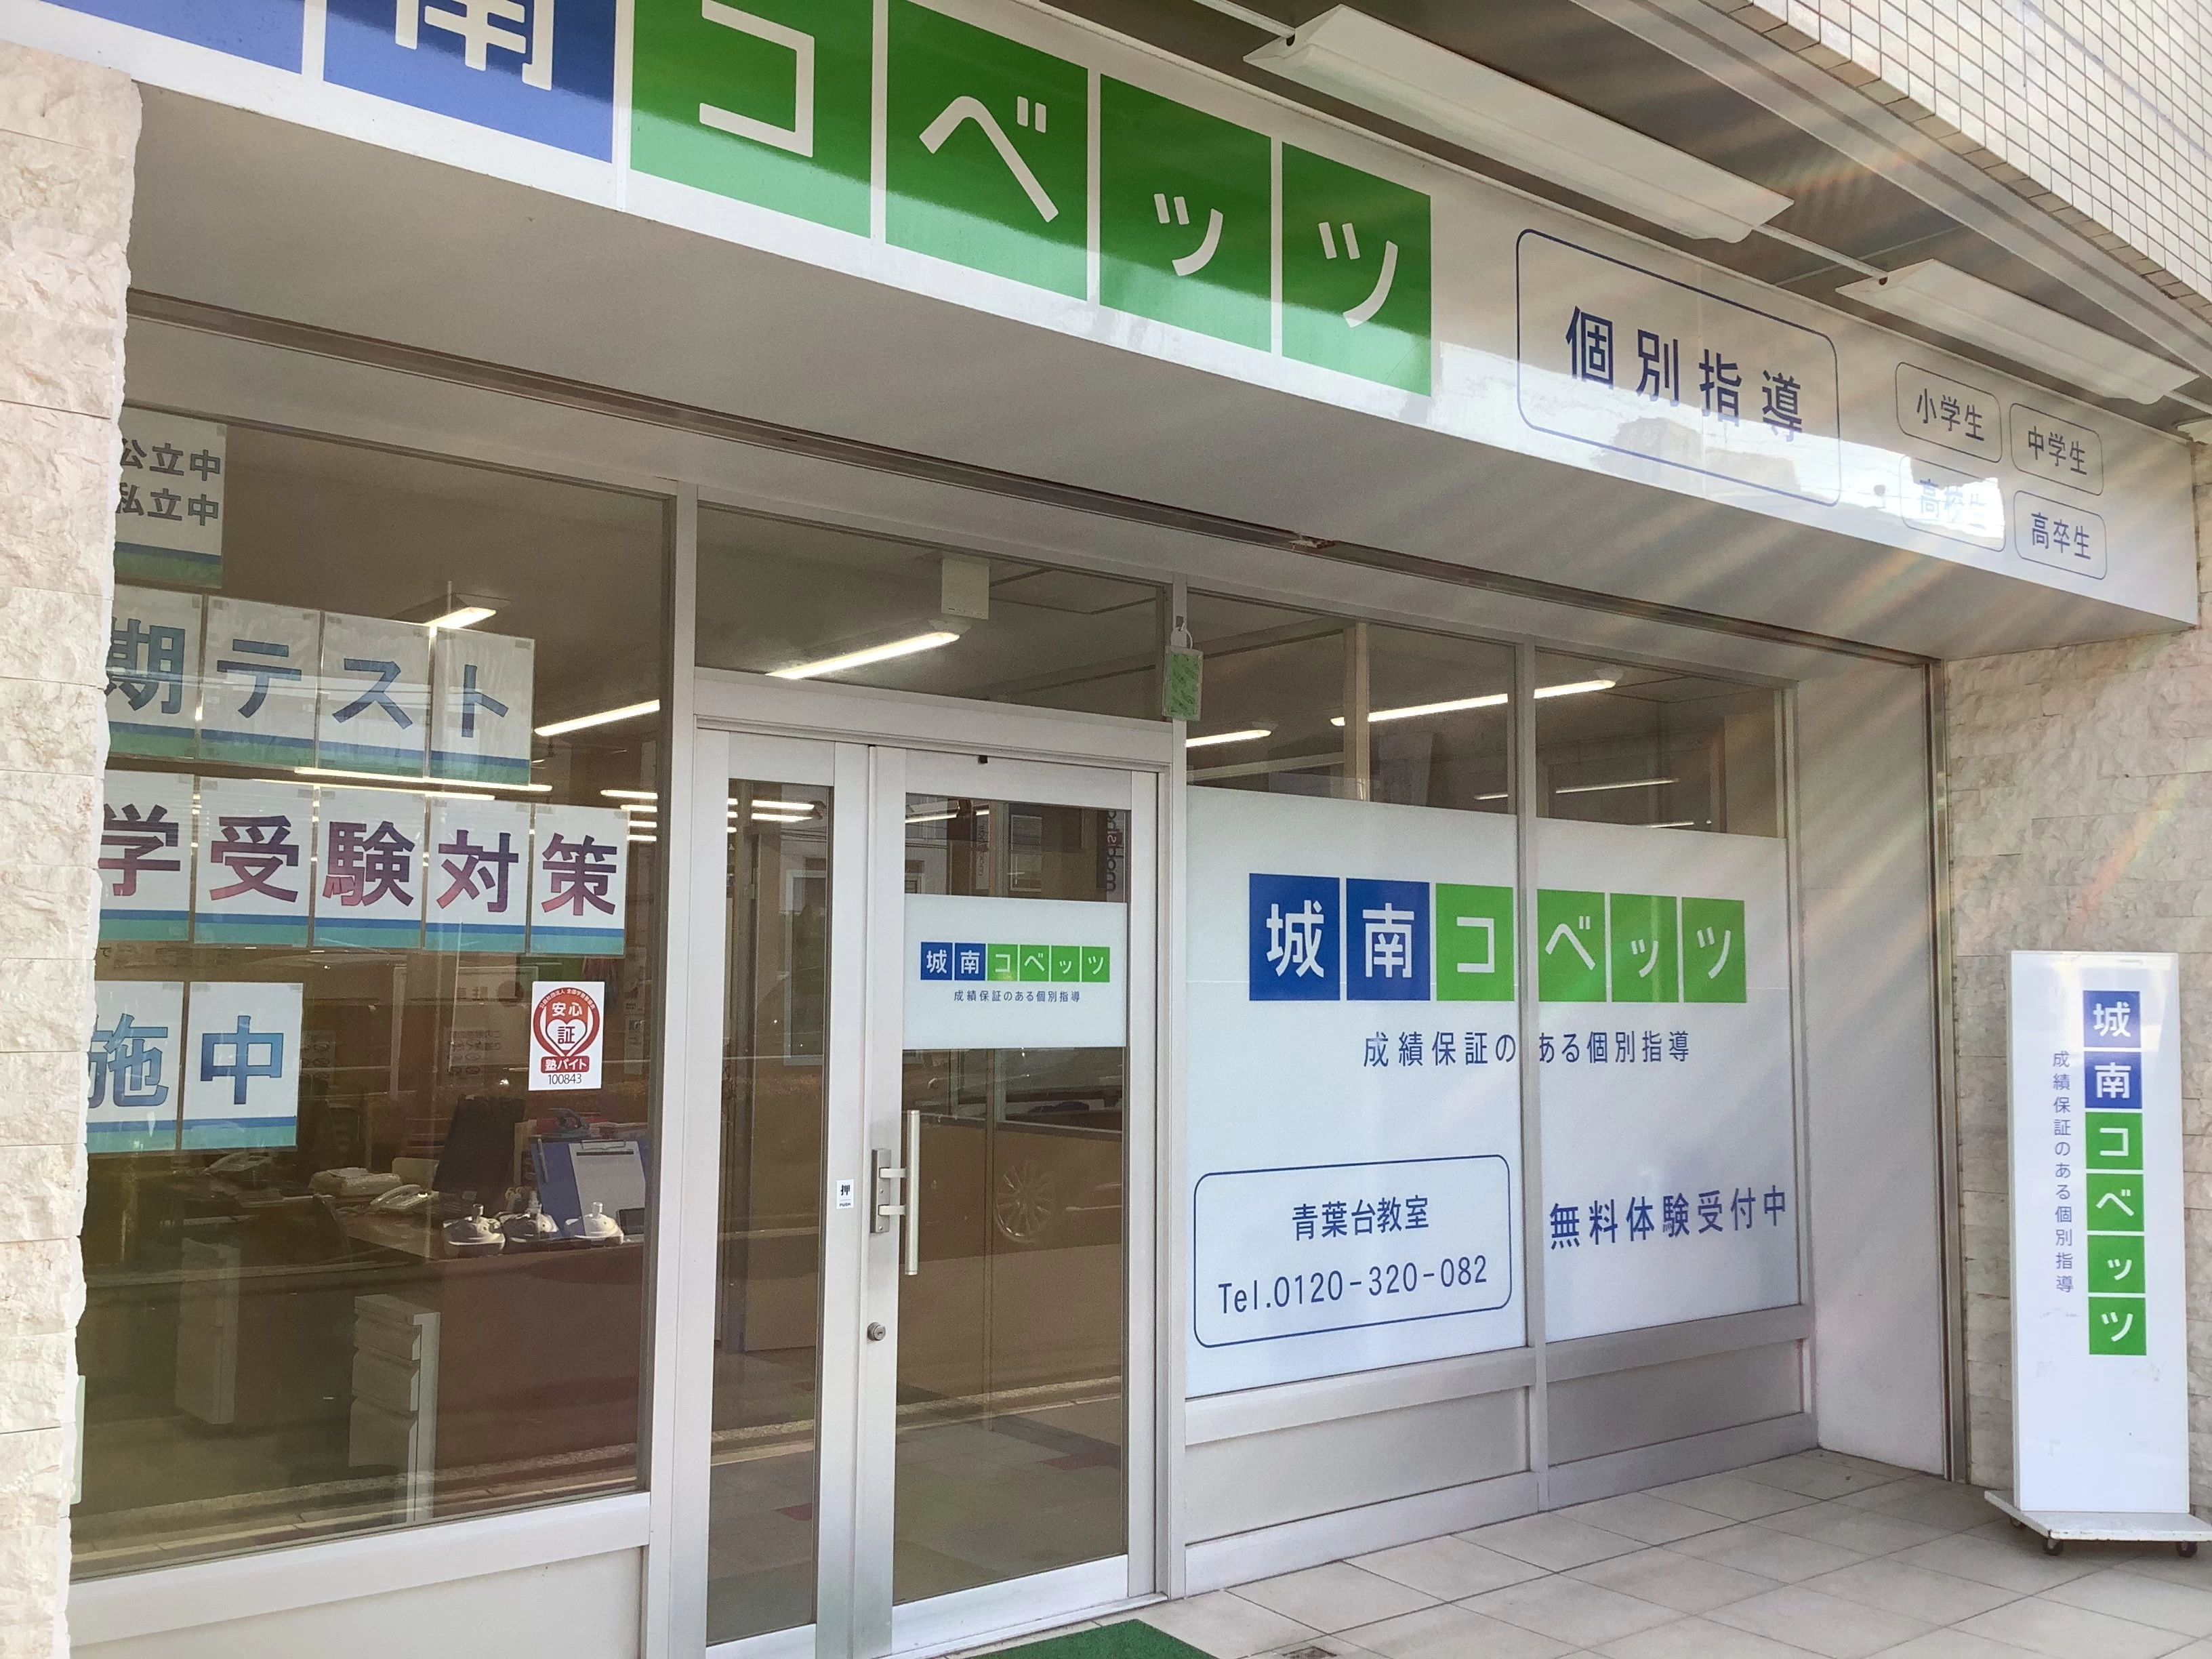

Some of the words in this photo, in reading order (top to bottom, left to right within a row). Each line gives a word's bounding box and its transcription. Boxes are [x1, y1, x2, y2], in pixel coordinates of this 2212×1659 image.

[1565, 306, 1803, 443] 個別指導
[1917, 388, 1984, 441] 小学生
[120, 438, 221, 481] 公立中
[2027, 425, 2087, 476] 中学生
[2030, 512, 2091, 560] 高卒生
[104, 616, 509, 739] 期テスト
[98, 803, 617, 916] 学受験対策
[926, 949, 1104, 975] 城南コベッツ
[1265, 899, 1732, 981] 城南コベッツ
[552, 1002, 583, 1017] 安心
[954, 989, 1081, 1002] 成績保証のある個別指導
[557, 1026, 575, 1044] 証
[1362, 1029, 1691, 1067] 成績保証のある個別指導
[87, 1012, 284, 1109] 施中
[544, 1058, 587, 1071] 塾バイト
[548, 1073, 582, 1085] 100843
[840, 1184, 851, 1196] 押
[2051, 1050, 2074, 1294] 成績保証のある個別指導
[2091, 1001, 2134, 1343] 城南コベッツ
[1291, 1193, 1430, 1242] 青葉台教室
[1548, 1184, 1788, 1251] 無料体験受付中
[1217, 1254, 1488, 1315] Tel.0120-320-082
